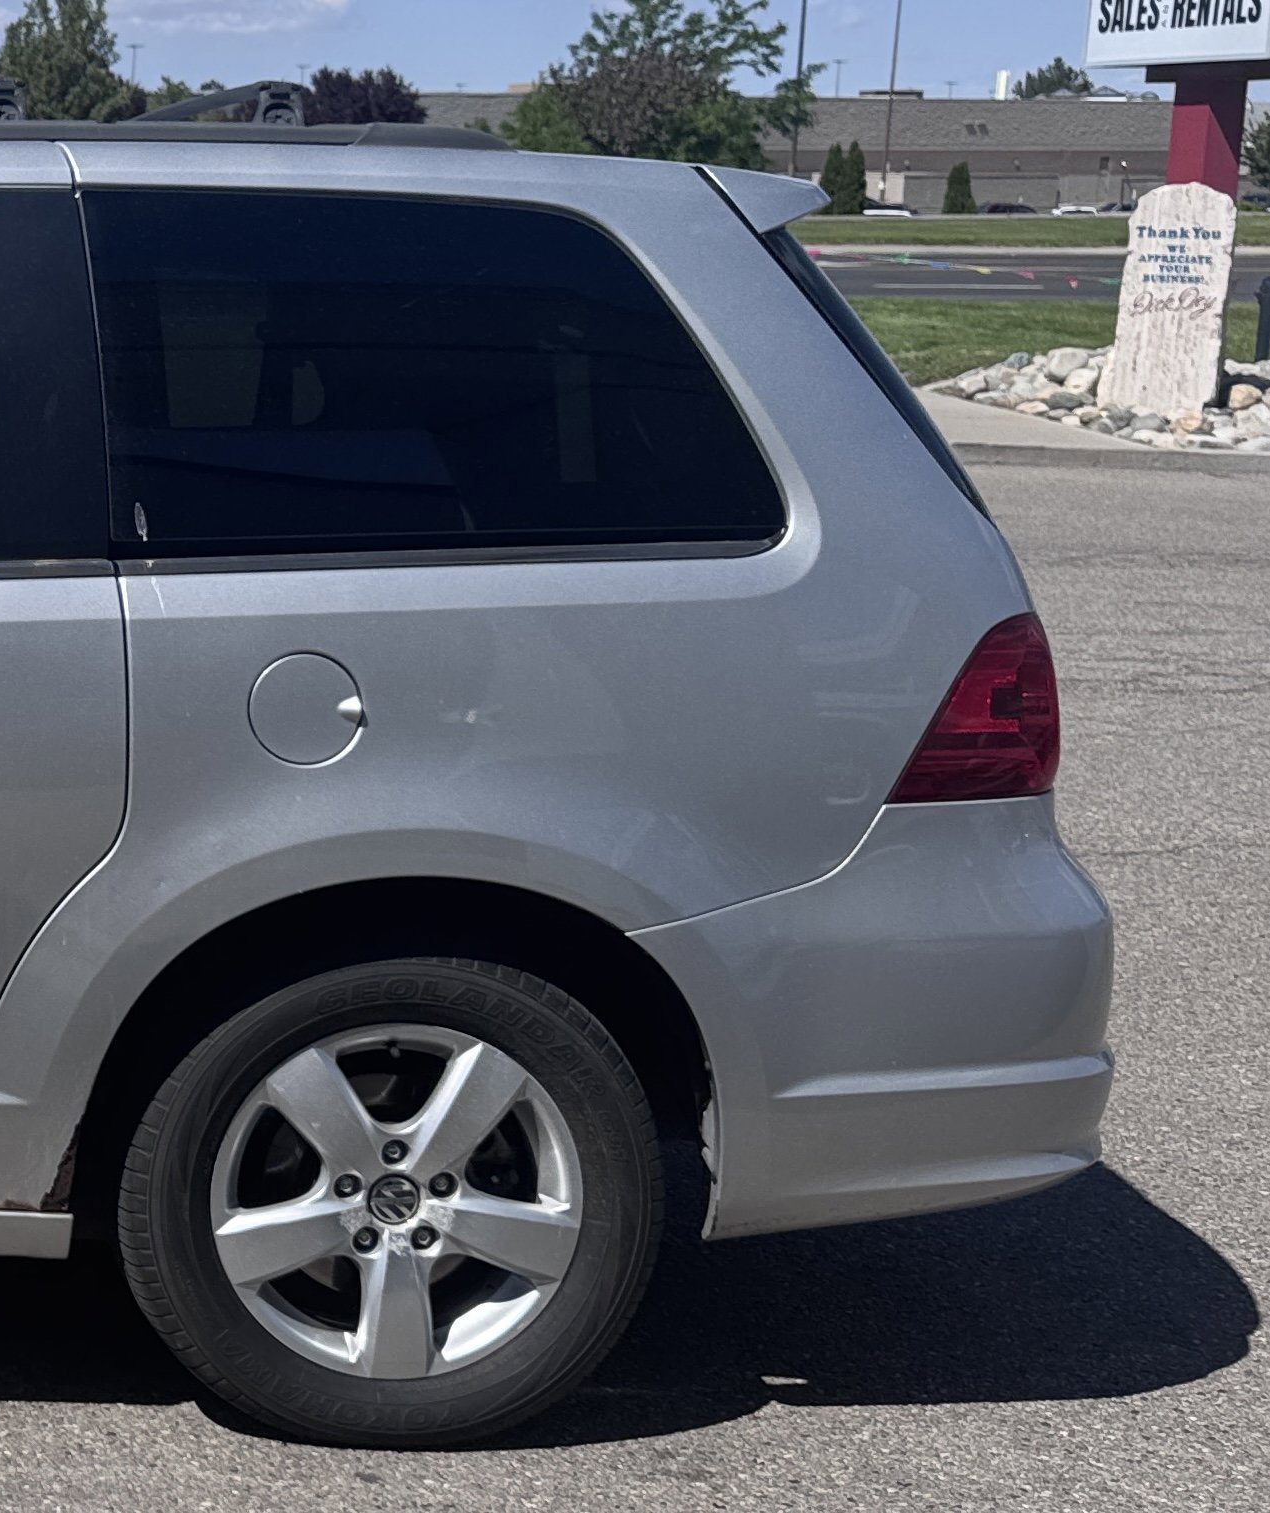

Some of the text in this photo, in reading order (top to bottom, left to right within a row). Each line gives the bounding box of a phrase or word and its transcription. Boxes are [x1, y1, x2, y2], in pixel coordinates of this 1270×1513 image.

[1098, 0, 1160, 33] SALES
[1170, 0, 1262, 28] RENTALS
[1136, 226, 1221, 240] Thank You
[1138, 254, 1213, 265] APPRECIATE
[1158, 265, 1190, 273] YOUR
[316, 976, 607, 1100] GEOLANDAR
